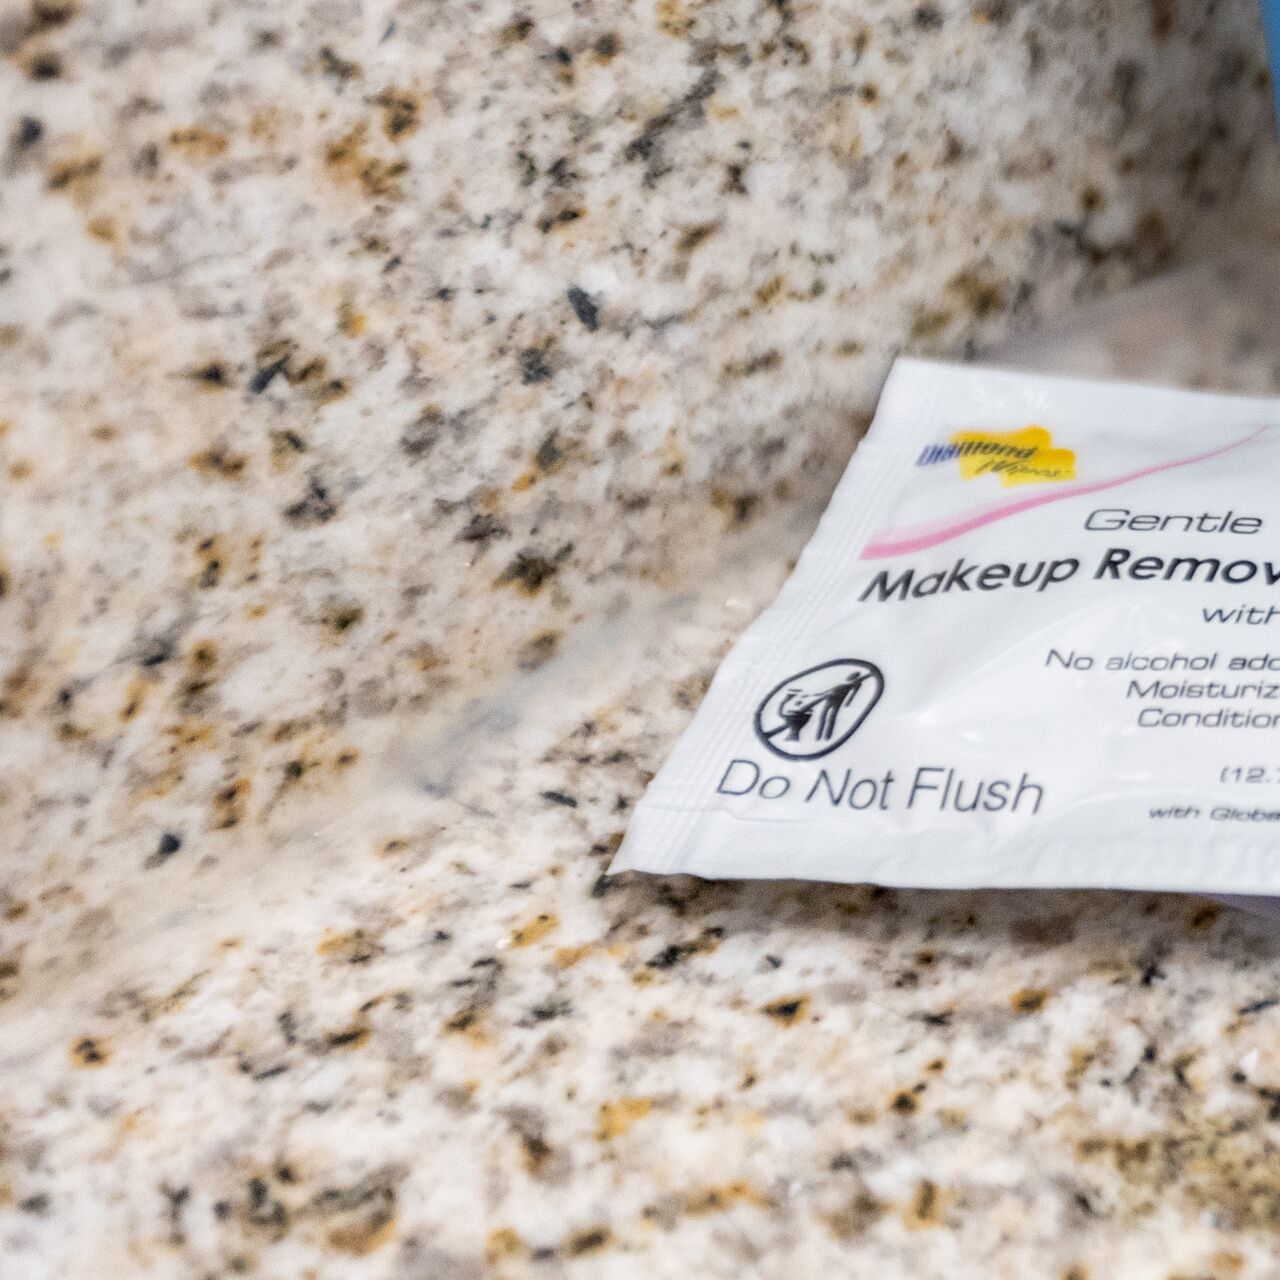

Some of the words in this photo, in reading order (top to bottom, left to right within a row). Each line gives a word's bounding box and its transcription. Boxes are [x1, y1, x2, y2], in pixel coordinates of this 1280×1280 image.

[1084, 508, 1263, 535] Gentle
[857, 557, 1080, 602] Makeup
[1045, 650, 1094, 671] No
[1106, 652, 1217, 672] alcohol
[715, 759, 791, 800] Do
[805, 768, 895, 810] Not
[906, 767, 1044, 815] Flush
[1148, 806, 1201, 820] with
